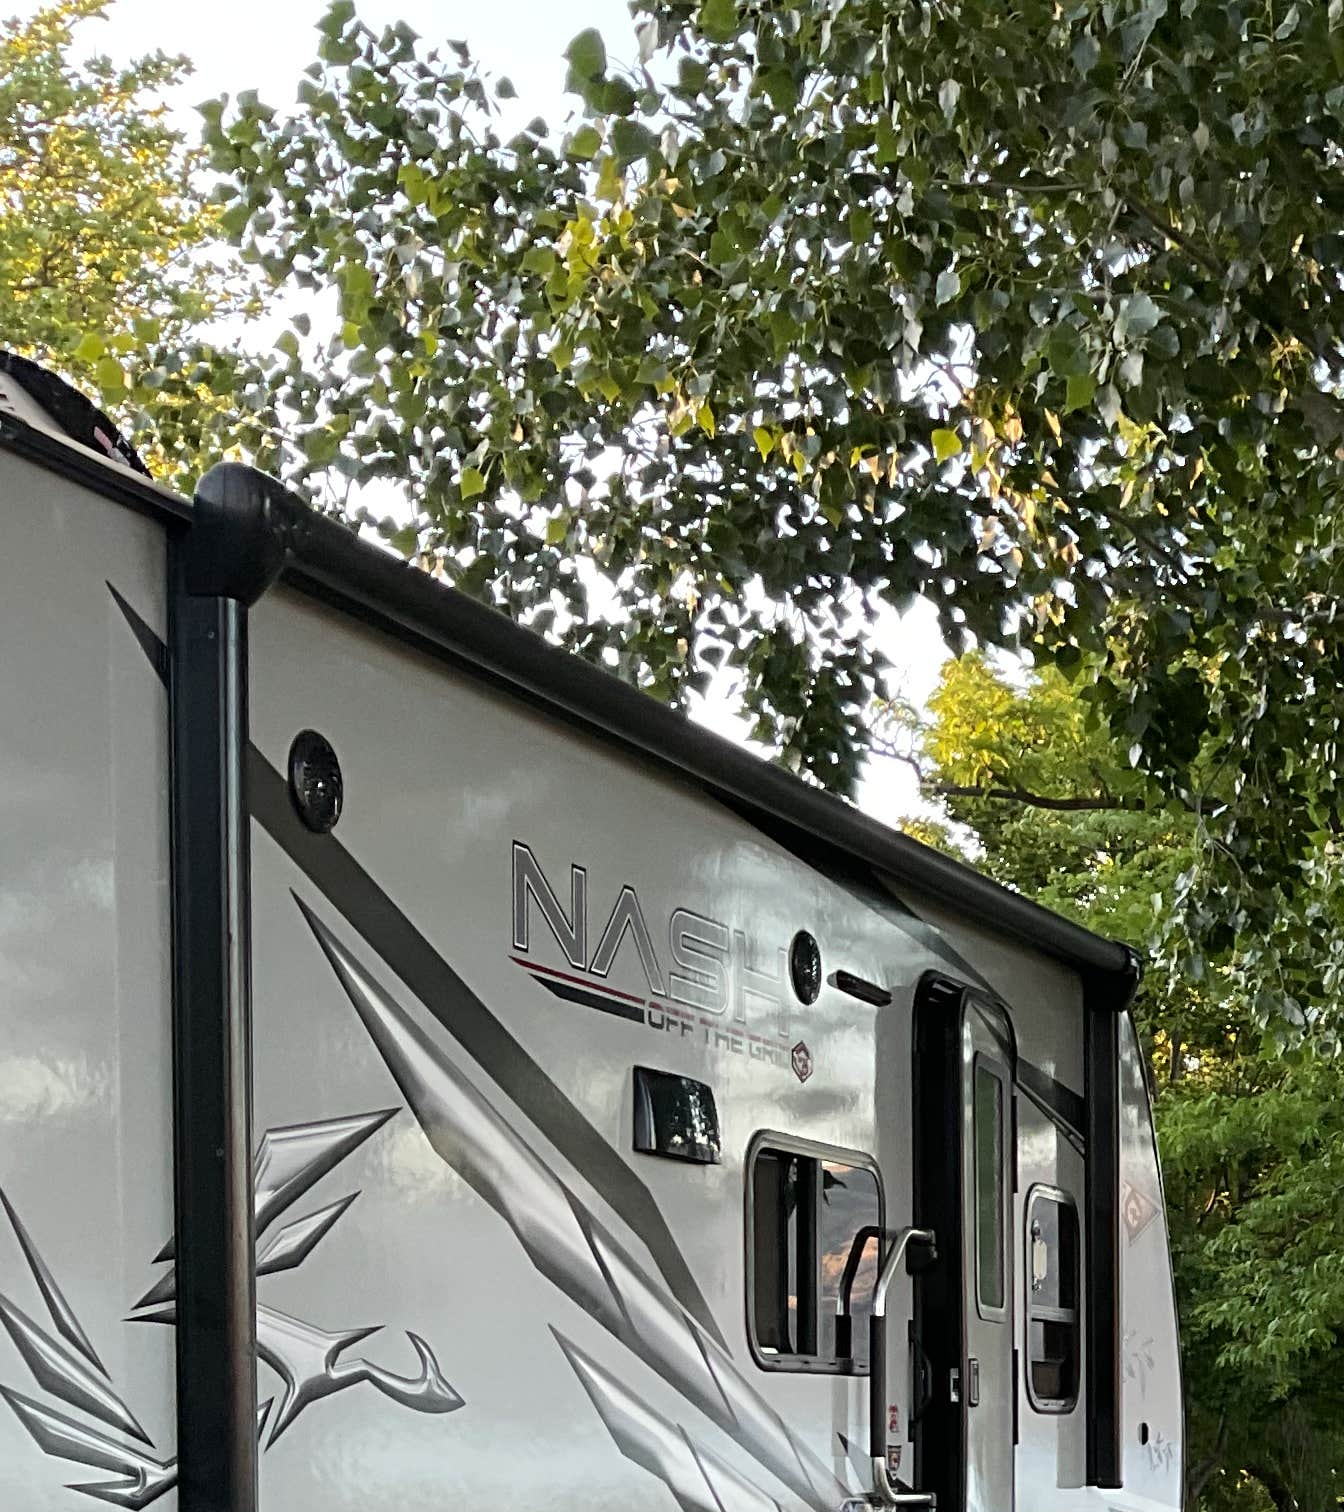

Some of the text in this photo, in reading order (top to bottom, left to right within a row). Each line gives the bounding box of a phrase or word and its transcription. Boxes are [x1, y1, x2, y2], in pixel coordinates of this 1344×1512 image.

[512, 839, 790, 1038] NASH
[648, 1001, 694, 1037] OFF
[699, 1017, 743, 1055] THE
